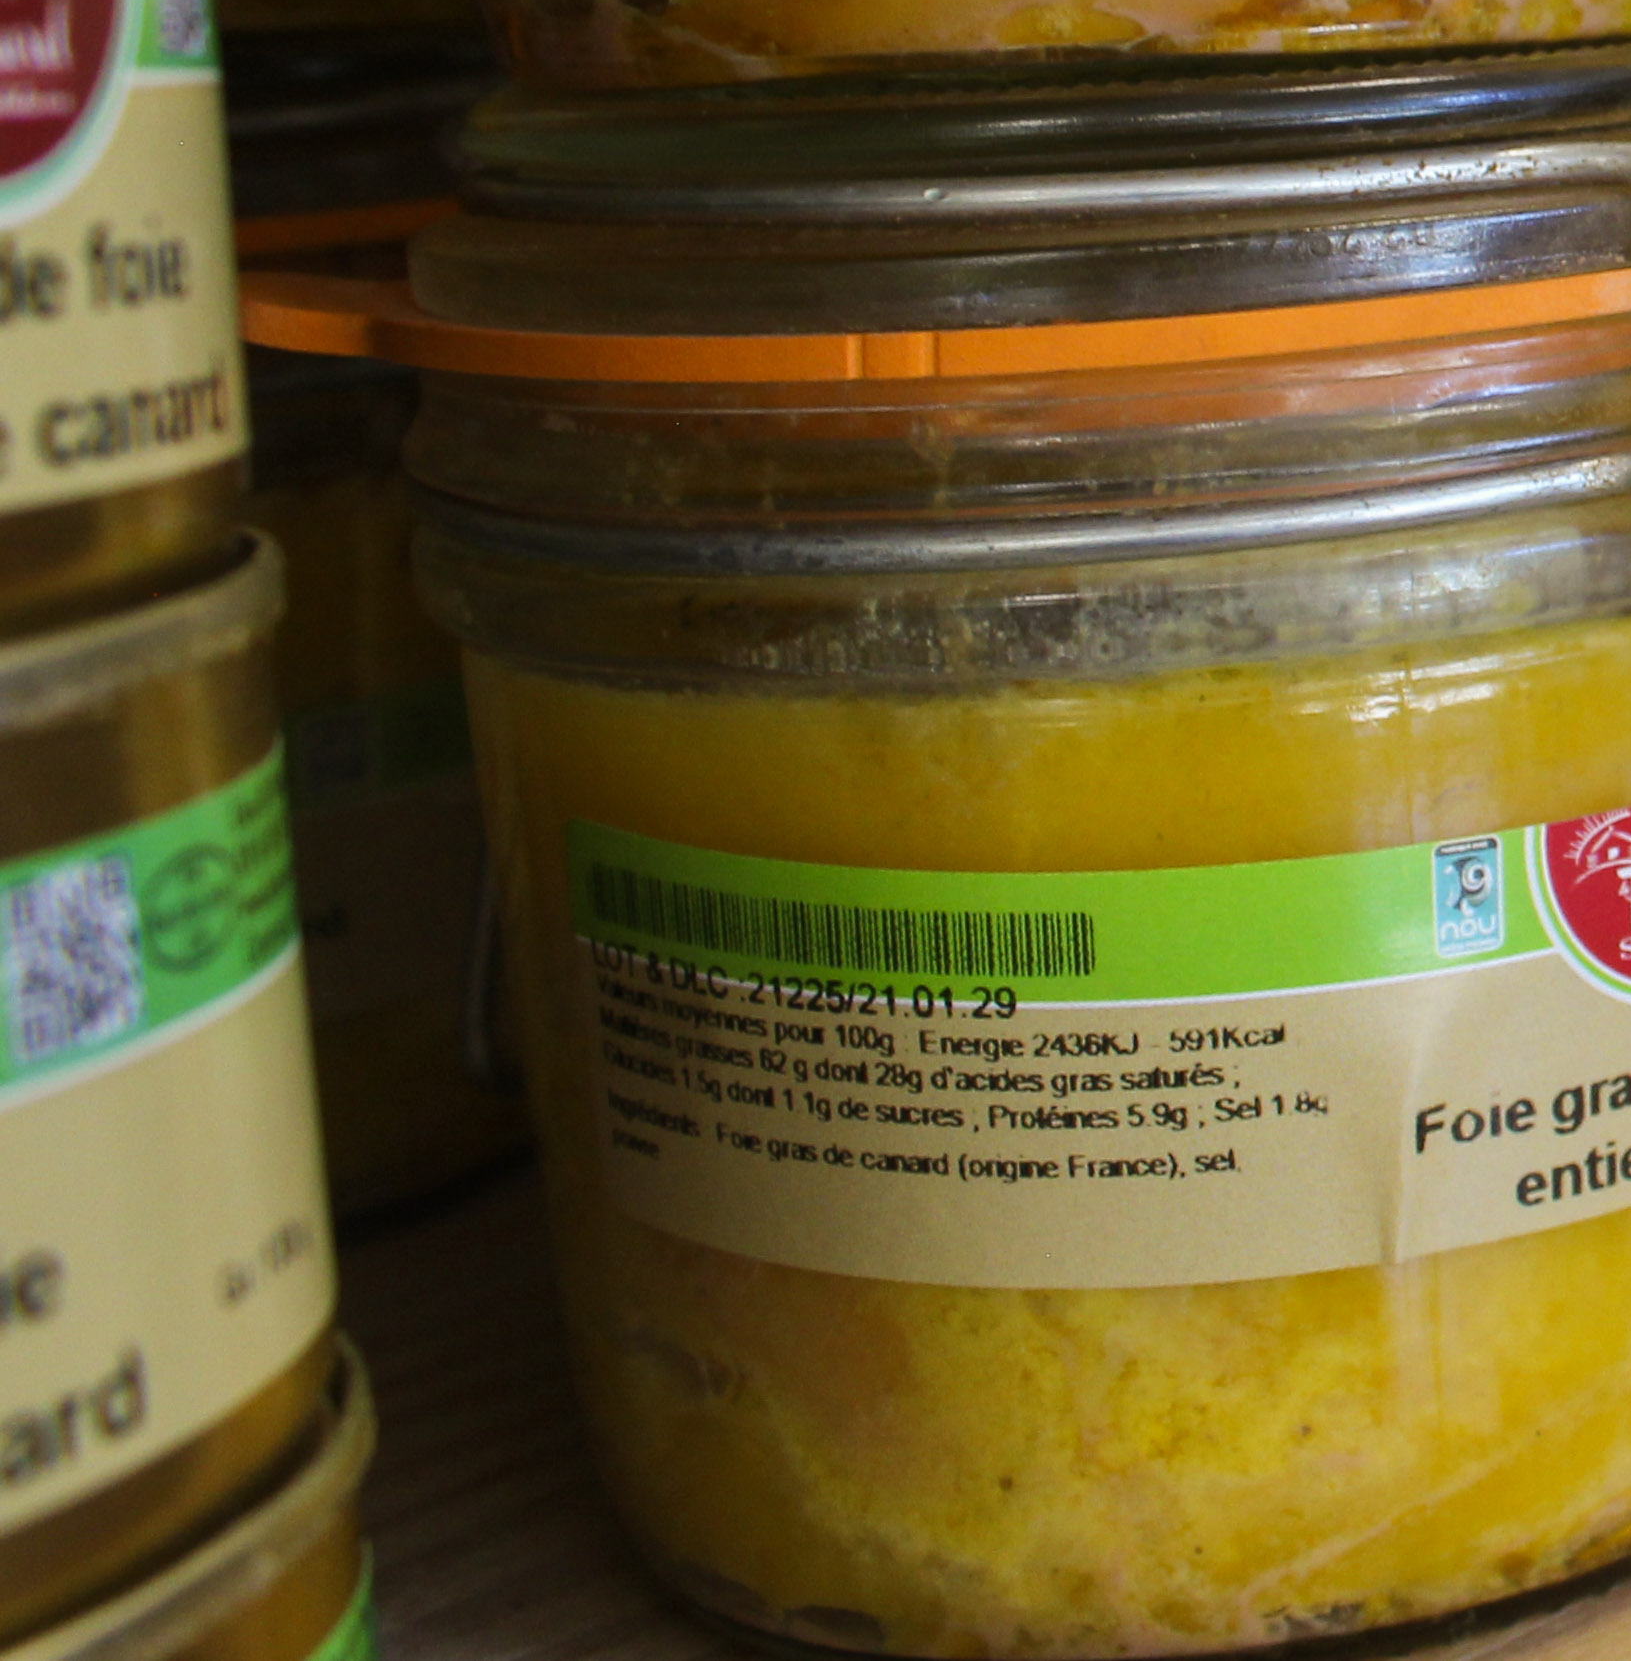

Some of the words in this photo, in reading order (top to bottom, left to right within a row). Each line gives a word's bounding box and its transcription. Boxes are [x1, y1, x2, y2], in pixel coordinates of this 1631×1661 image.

[774, 1019, 825, 1050] pour
[834, 1024, 895, 1056] 100g
[1169, 1022, 1287, 1054] 591Kcal
[793, 1060, 809, 1083] g
[815, 1056, 869, 1084] dont
[875, 1062, 923, 1094] 28g
[930, 1066, 1044, 1093] d'acides
[1051, 1068, 1114, 1098] gras
[726, 1082, 776, 1108] dont
[838, 1093, 870, 1121] de
[875, 1103, 964, 1128] sucres
[1214, 1095, 1262, 1123] Sel
[1415, 1094, 1535, 1155] Foie
[767, 1138, 819, 1163] gras
[823, 1143, 853, 1169] de
[860, 1146, 949, 1177] canard
[957, 1152, 1059, 1184] (origine
[0, 1343, 149, 1485] ard
